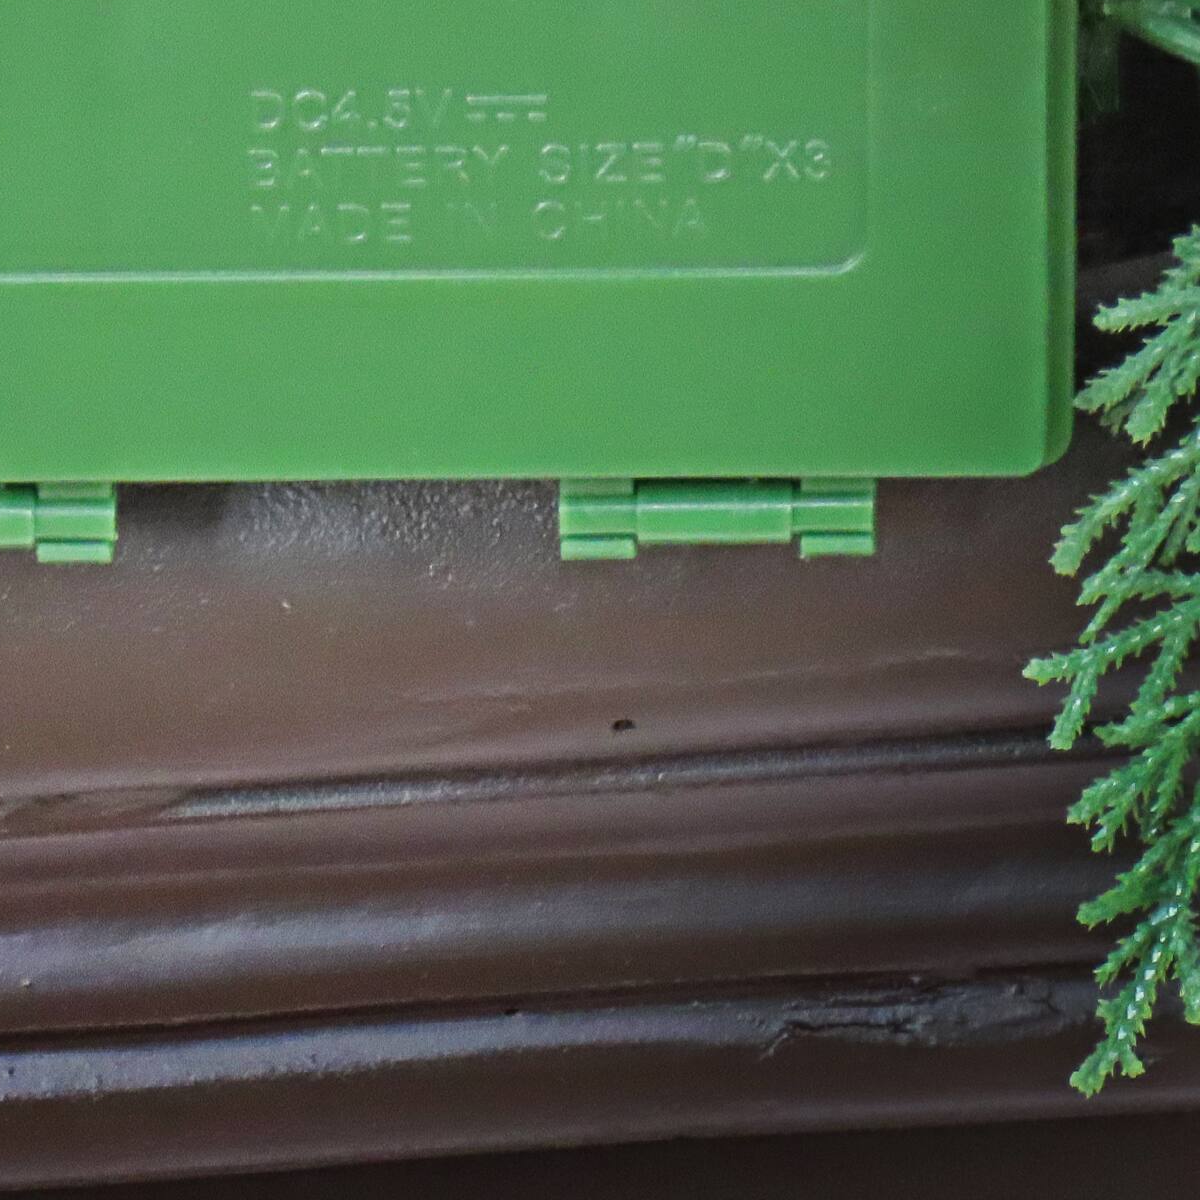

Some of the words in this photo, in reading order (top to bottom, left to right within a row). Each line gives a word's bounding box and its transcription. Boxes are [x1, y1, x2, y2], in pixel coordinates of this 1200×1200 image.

[248, 144, 510, 189] BATTERY
[249, 201, 414, 246] MADE
[533, 198, 709, 241] CHINA
